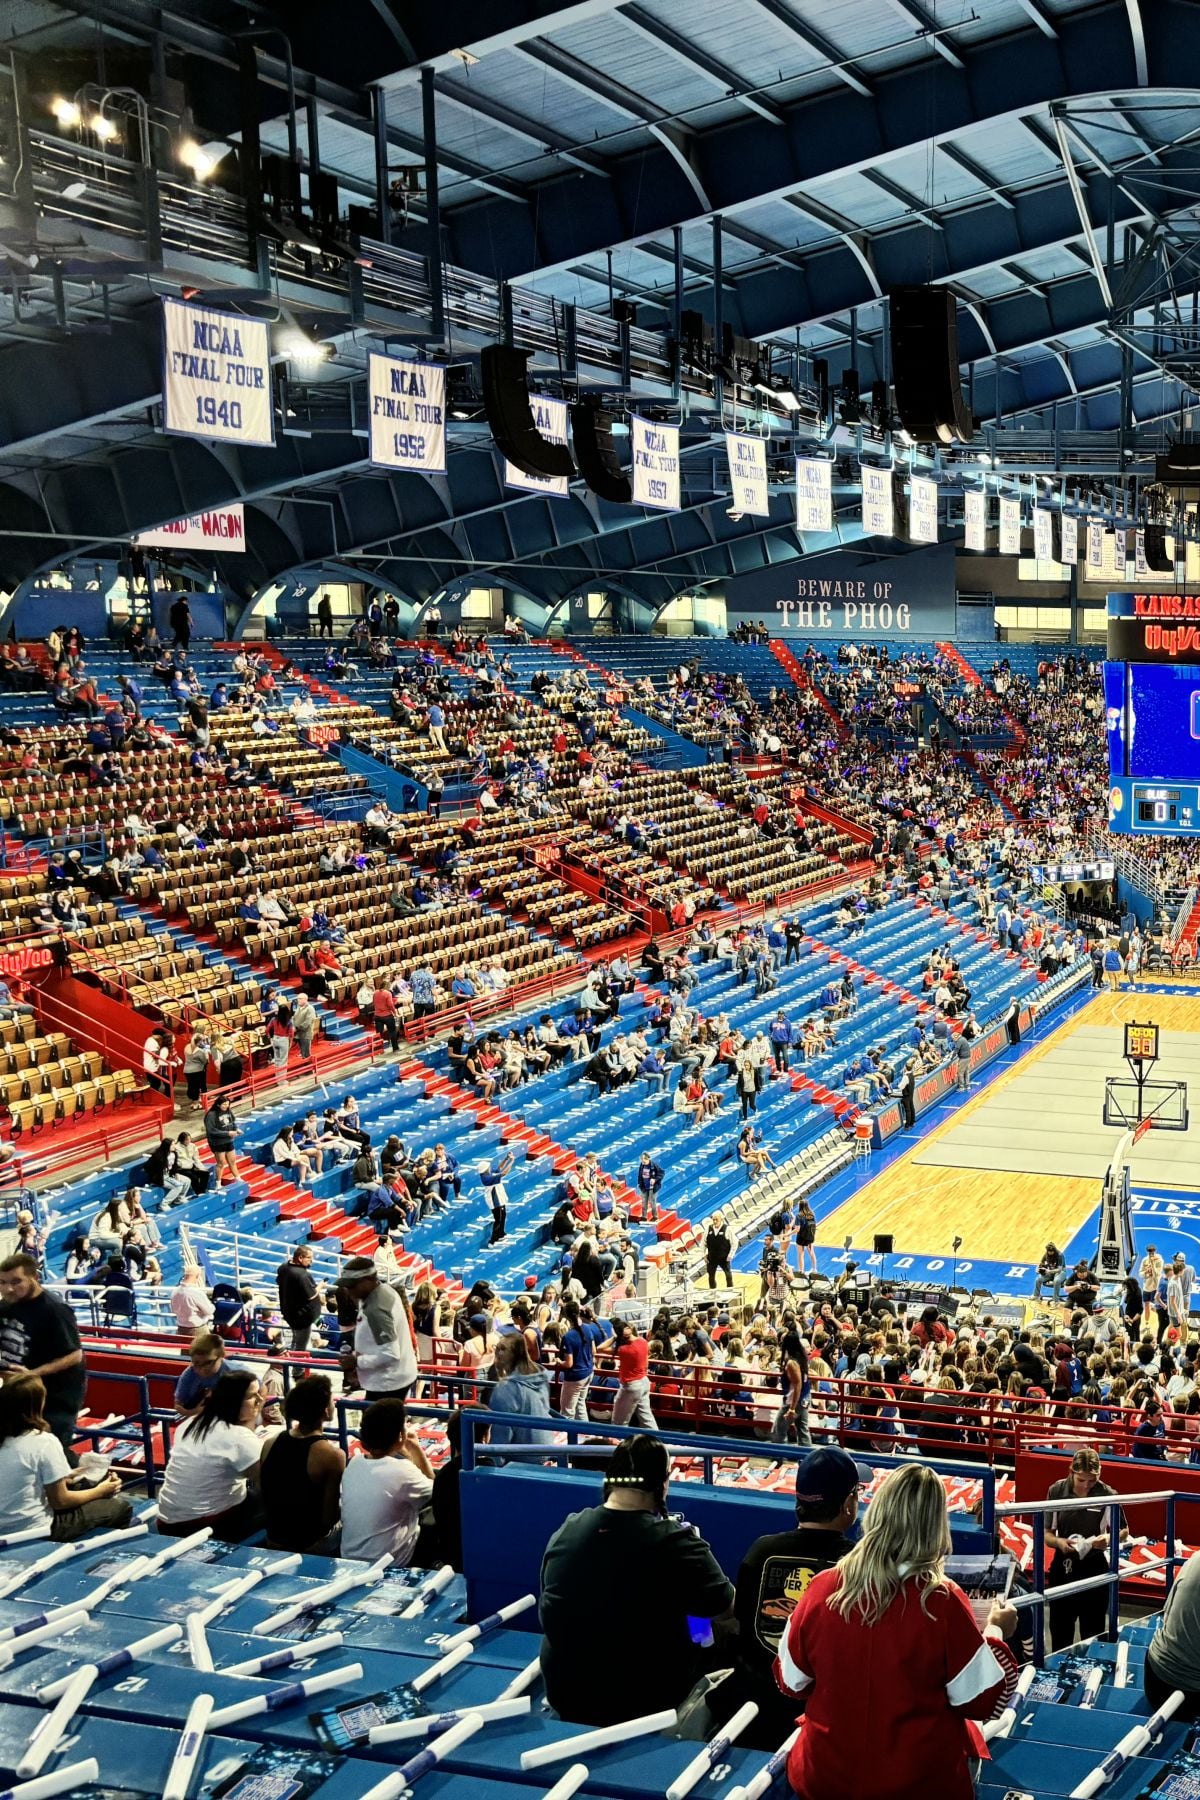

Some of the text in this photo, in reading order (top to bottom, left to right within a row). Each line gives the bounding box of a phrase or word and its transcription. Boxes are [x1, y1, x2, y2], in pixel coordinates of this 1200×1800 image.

[193, 320, 244, 358] NCAA
[172, 351, 265, 389] FINAL FOUR
[390, 368, 427, 398] NCAA
[196, 395, 242, 429] 1940
[373, 395, 442, 425] FINAL FOUR
[393, 433, 425, 459] 1952
[645, 430, 667, 453] NCAA
[737, 442, 756, 463] NCAA
[648, 479, 667, 500] 1957
[202, 512, 242, 538] WAGON
[292, 587, 304, 598] 18
[798, 579, 893, 599] BEWARE OF
[776, 600, 911, 630] THE PHOG
[1155, 802, 1167, 821] 0
[1182, 808, 1191, 819] 4
[770, 1567, 801, 1580] EDDIE
[289, 1657, 318, 1670] 12
[113, 1676, 150, 1693] 12
[1021, 1713, 1034, 1726] 7
[709, 1763, 732, 1781] 8
